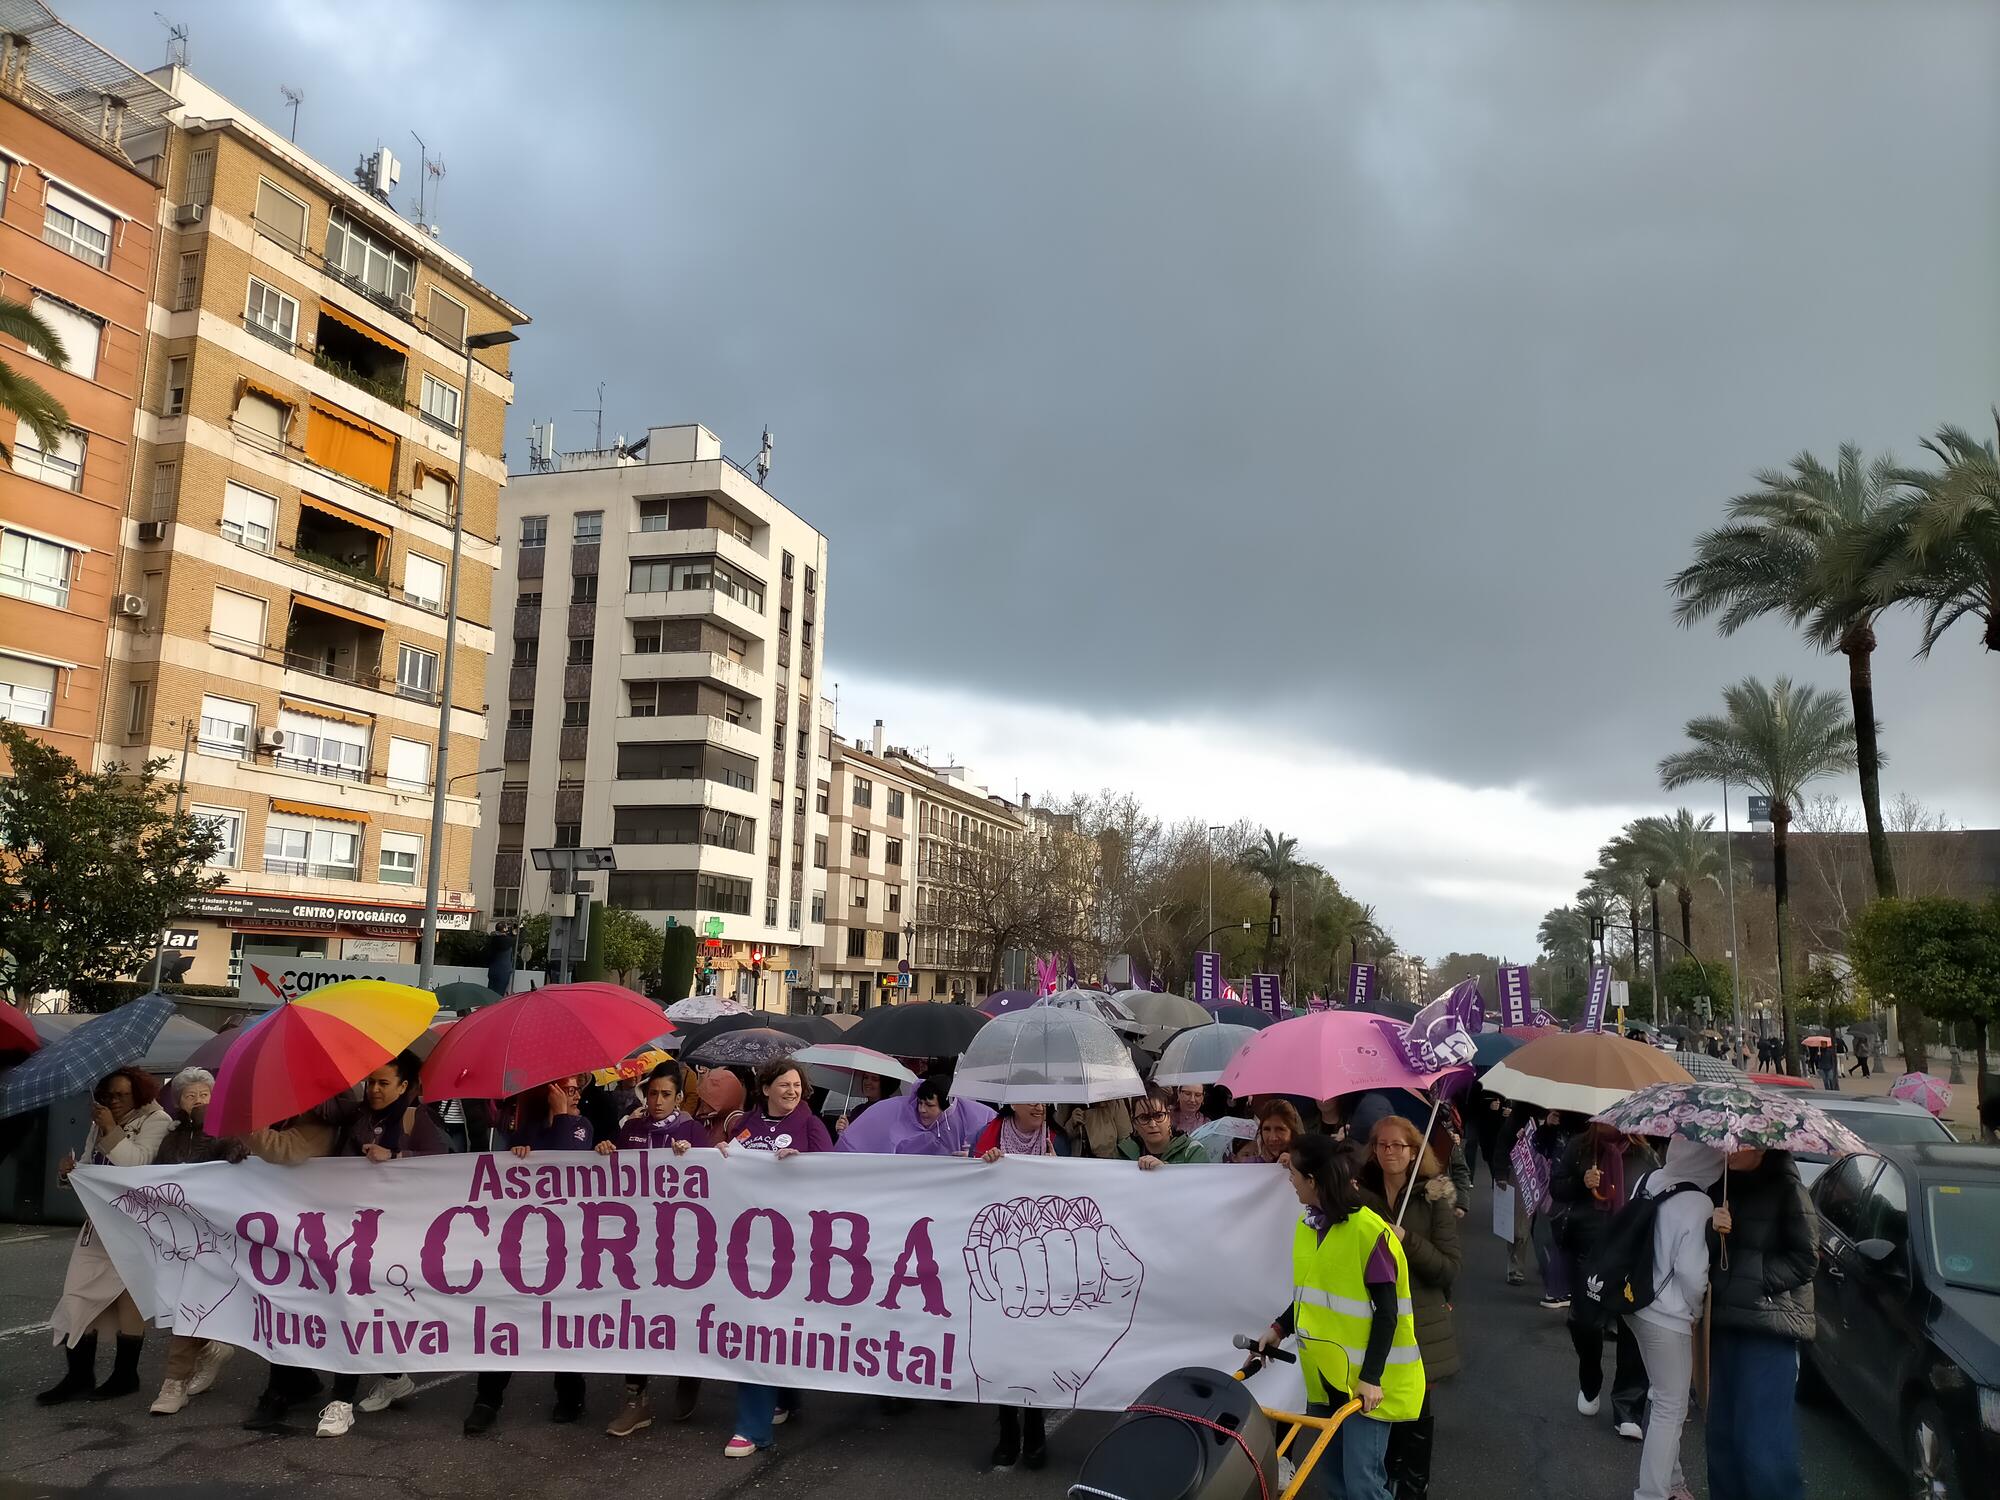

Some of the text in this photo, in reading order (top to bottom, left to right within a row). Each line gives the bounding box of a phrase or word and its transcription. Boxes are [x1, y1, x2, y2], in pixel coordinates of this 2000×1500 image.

[292, 905, 407, 924] CENTRO FOTOGRÁFICO
[1202, 954, 1213, 1000] CCOO
[1260, 977, 1273, 1014] CCO
[1507, 969, 1524, 1024] CCOO
[1589, 968, 1604, 1016] CCOO
[468, 1151, 710, 1202] Asamblea
[235, 1197, 952, 1318] 8M CÓRDOBA
[340, 1308, 450, 1356] viva
[474, 1306, 519, 1357] la
[541, 1298, 677, 1352] lucha
[696, 1304, 956, 1391] feminista!
